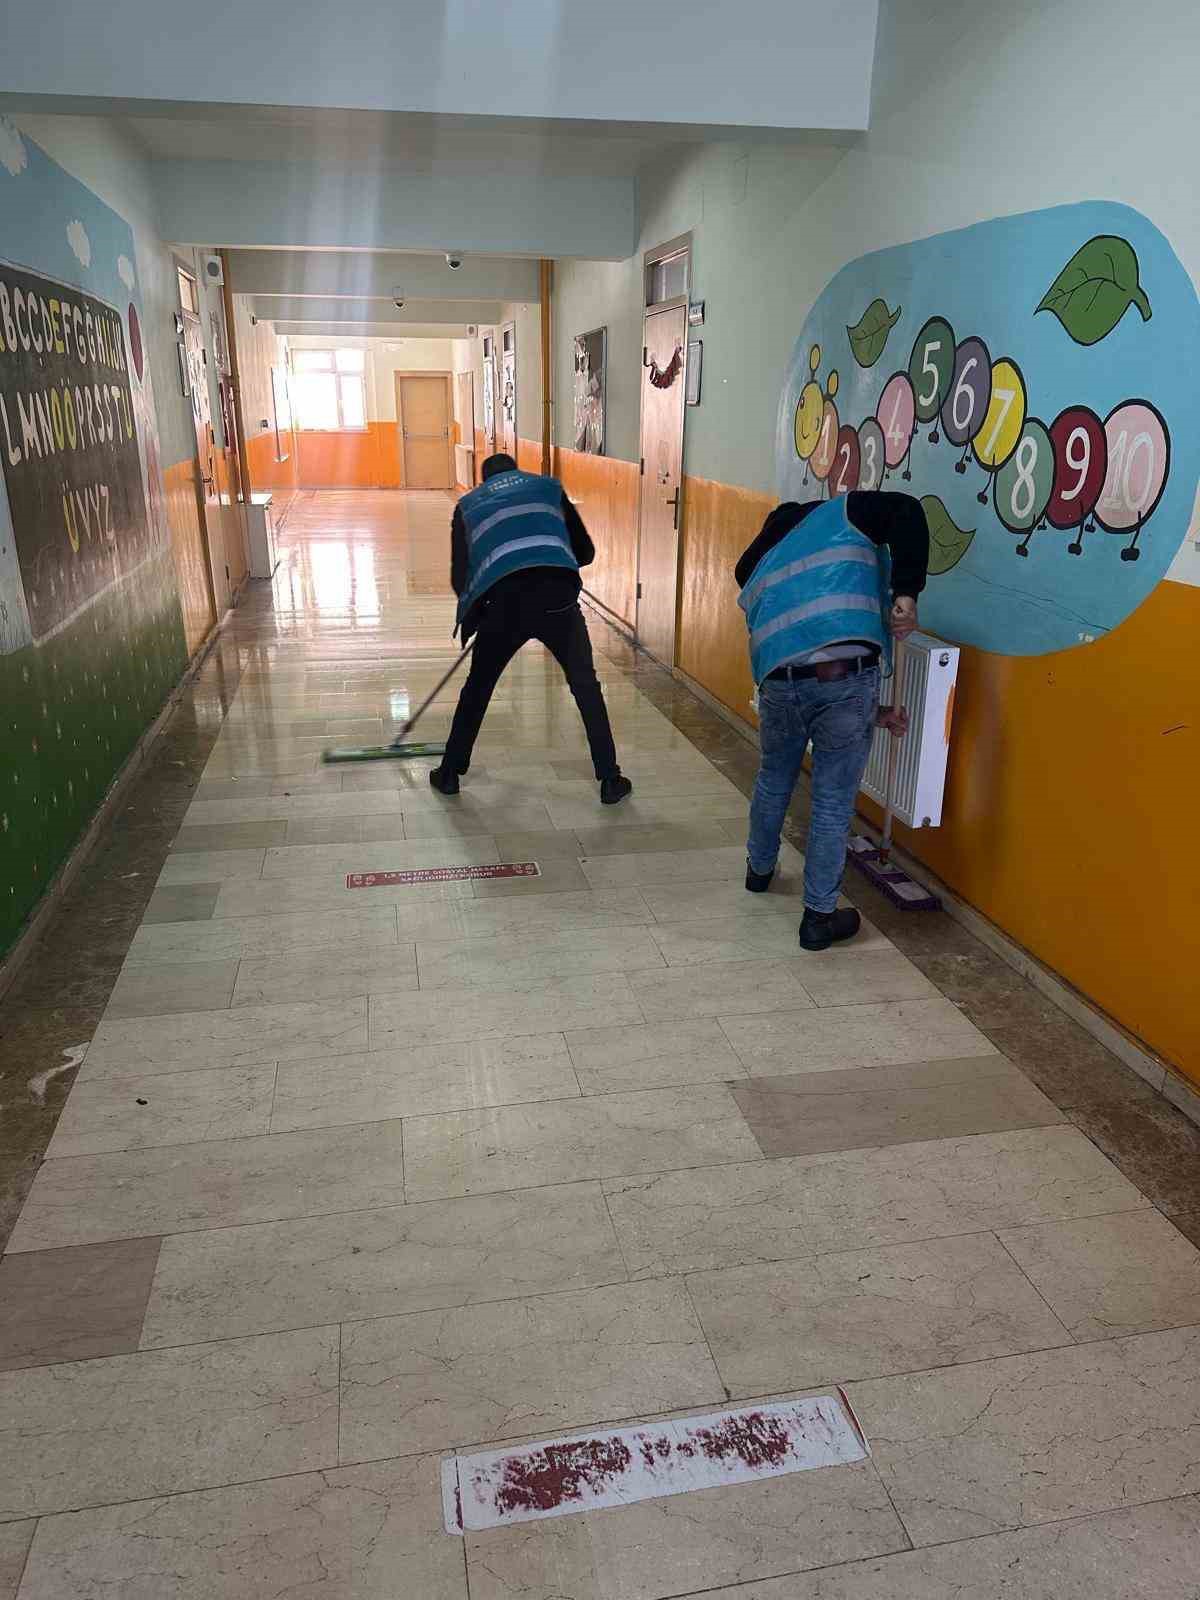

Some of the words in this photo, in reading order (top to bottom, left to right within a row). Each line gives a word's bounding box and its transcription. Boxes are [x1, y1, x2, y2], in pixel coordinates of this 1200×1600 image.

[821, 414, 832, 465] 1
[836, 442, 851, 493] 2
[861, 436, 877, 490] 3
[887, 388, 904, 447] 4
[918, 340, 941, 407] 5
[952, 357, 978, 430] 6
[983, 387, 1017, 457] 7
[1011, 436, 1038, 519] 8
[1061, 426, 1091, 501] 9
[1103, 430, 1154, 510] 10
